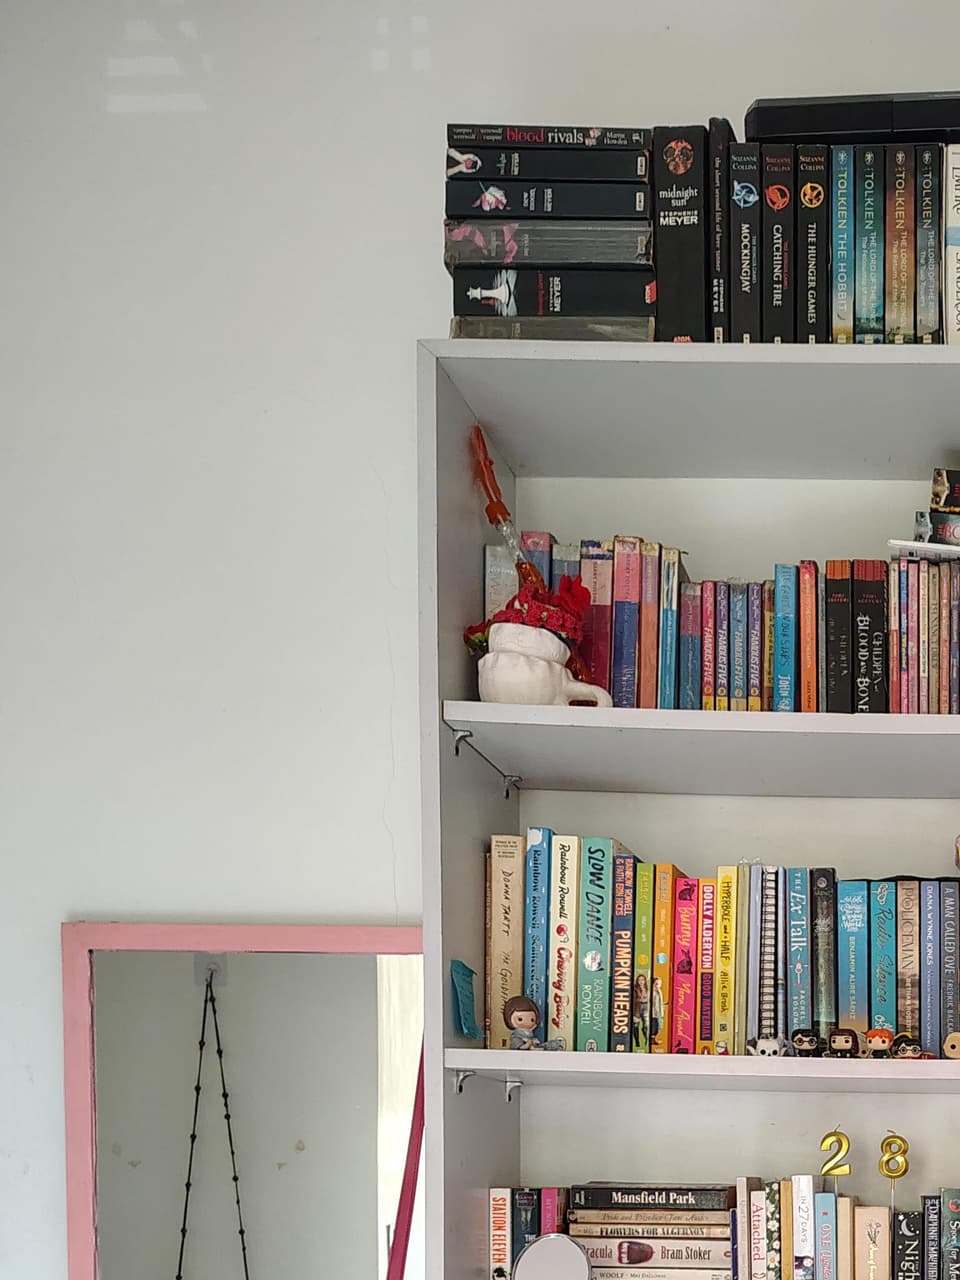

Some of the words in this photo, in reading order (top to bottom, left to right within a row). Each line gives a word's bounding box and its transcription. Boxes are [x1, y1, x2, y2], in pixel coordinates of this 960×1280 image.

[506, 128, 545, 144] blood
[548, 129, 584, 144] rivals
[659, 184, 698, 200] midnight
[671, 198, 687, 207] sun
[838, 172, 847, 229] TOLKIEN
[864, 172, 874, 230] TOLKIEN
[922, 171, 931, 229] TOLKIEN
[659, 217, 698, 227] MEYER
[808, 223, 817, 241] THE
[741, 223, 750, 293] MOCKINGJAY
[773, 224, 782, 274] CATCHING
[838, 233, 847, 258] THE
[808, 244, 816, 288] HUNGER
[773, 278, 782, 308] FIRE
[838, 261, 847, 312] HOBBIT
[808, 290, 816, 324] GAMES
[703, 627, 713, 661] FAMOUS
[703, 662, 713, 684] FIVE
[559, 843, 571, 884] Rainbow
[587, 847, 605, 890] SLOW
[501, 869, 513, 900] DONNA
[703, 885, 713, 917] DOLLY
[499, 903, 512, 936] TARTT
[559, 886, 570, 920] Rowell
[586, 892, 605, 946] DANCE
[790, 892, 807, 913] Ex
[944, 898, 955, 918] MAN
[676, 903, 696, 953] Bunny
[701, 918, 712, 969] ALDERTON
[790, 917, 807, 951] Talk
[944, 920, 955, 955] CALLED
[614, 930, 631, 988] PUMPKIN
[944, 957, 955, 976] OVE
[581, 984, 592, 1025] ROWELL
[593, 979, 603, 1030] RAINBOW
[613, 991, 630, 1034] HEADS
[820, 1131, 851, 1175] 2
[879, 1135, 909, 1179] 8
[612, 1192, 666, 1204] Mansfield
[669, 1192, 696, 1204] Park
[492, 1197, 506, 1235] STATION
[600, 1228, 639, 1236] FLOWERS
[661, 1227, 705, 1235] ALGERNON
[752, 1203, 765, 1261] Attached
[492, 1237, 506, 1263] ELEVEN
[661, 1246, 683, 1260] Bram
[685, 1246, 711, 1260] Stoker
